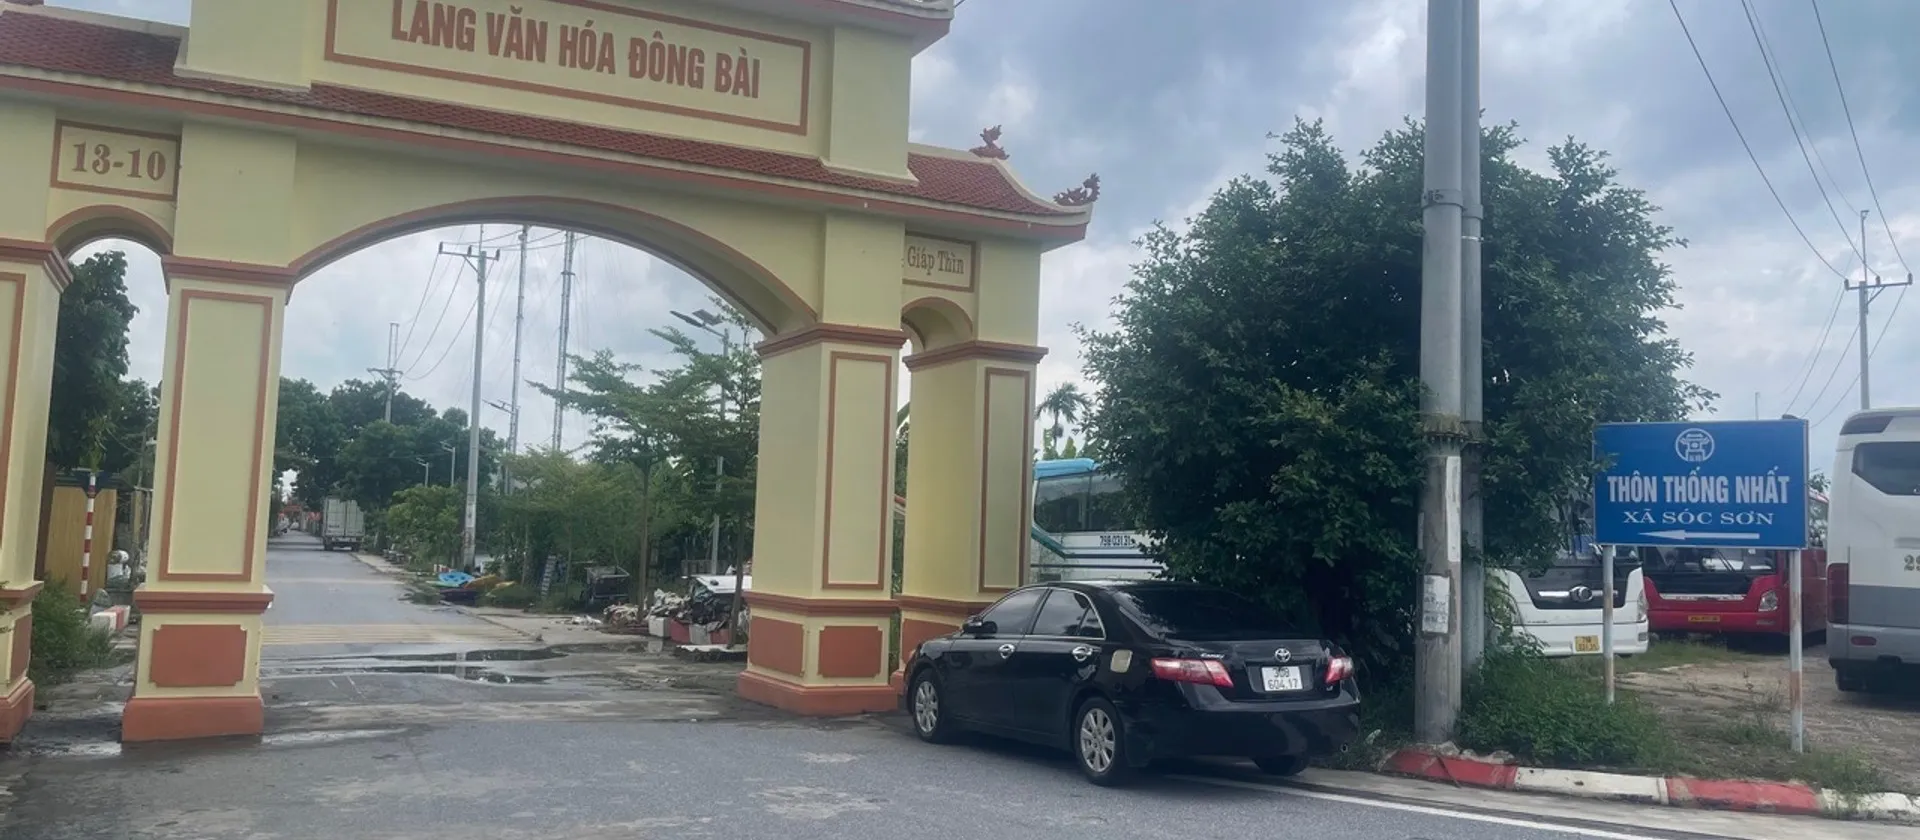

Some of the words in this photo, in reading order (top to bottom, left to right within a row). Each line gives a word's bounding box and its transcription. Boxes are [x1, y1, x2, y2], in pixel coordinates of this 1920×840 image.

[485, 5, 549, 63] VĂN
[558, 19, 616, 75] HÓA
[628, 30, 705, 90] ĐÔNG
[714, 46, 761, 99] BÀI
[72, 141, 166, 181] 13-10
[907, 245, 935, 276] Giáp
[937, 250, 965, 274] Thìn
[1607, 470, 1657, 504] THÔN
[1663, 466, 1729, 504] THỐNG
[1735, 465, 1790, 504] NHẤT
[1623, 508, 1656, 524] XÃ
[1662, 508, 1713, 525] SÓC
[1720, 511, 1774, 526] SƠN
